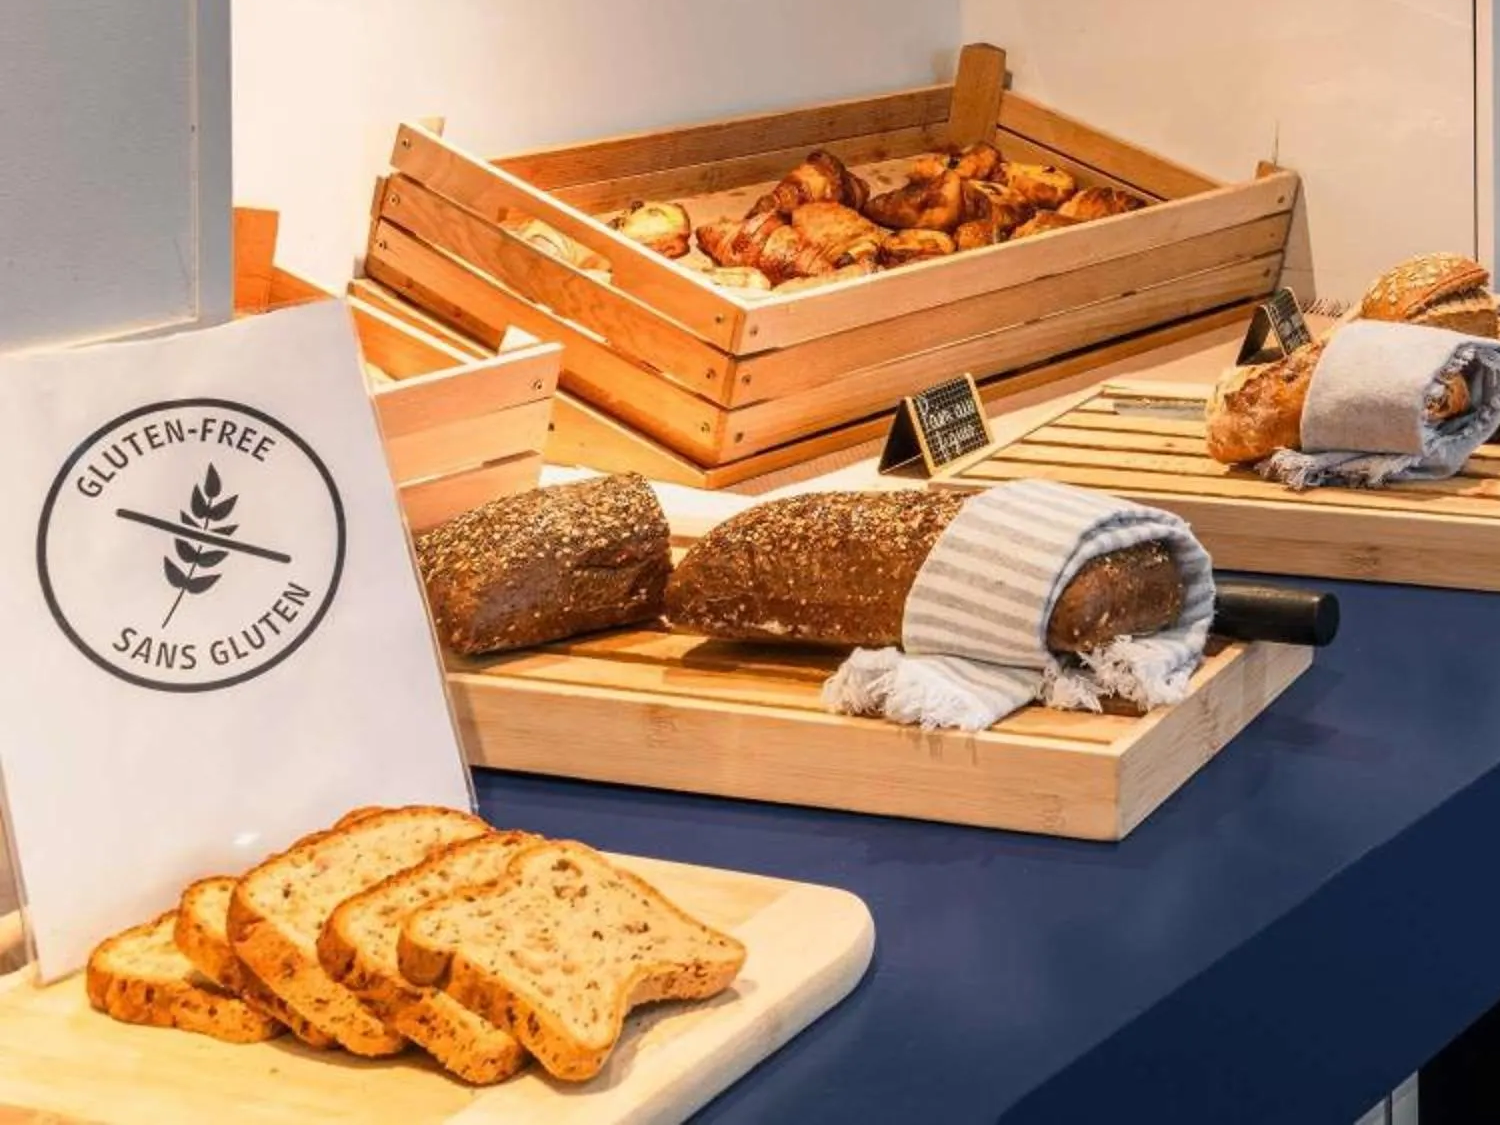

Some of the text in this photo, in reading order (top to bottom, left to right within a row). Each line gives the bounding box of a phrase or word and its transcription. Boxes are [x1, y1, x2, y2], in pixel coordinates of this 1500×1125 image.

[76, 417, 277, 499] GLUTEN-FREE
[111, 581, 312, 670] SANS GLUTEN
